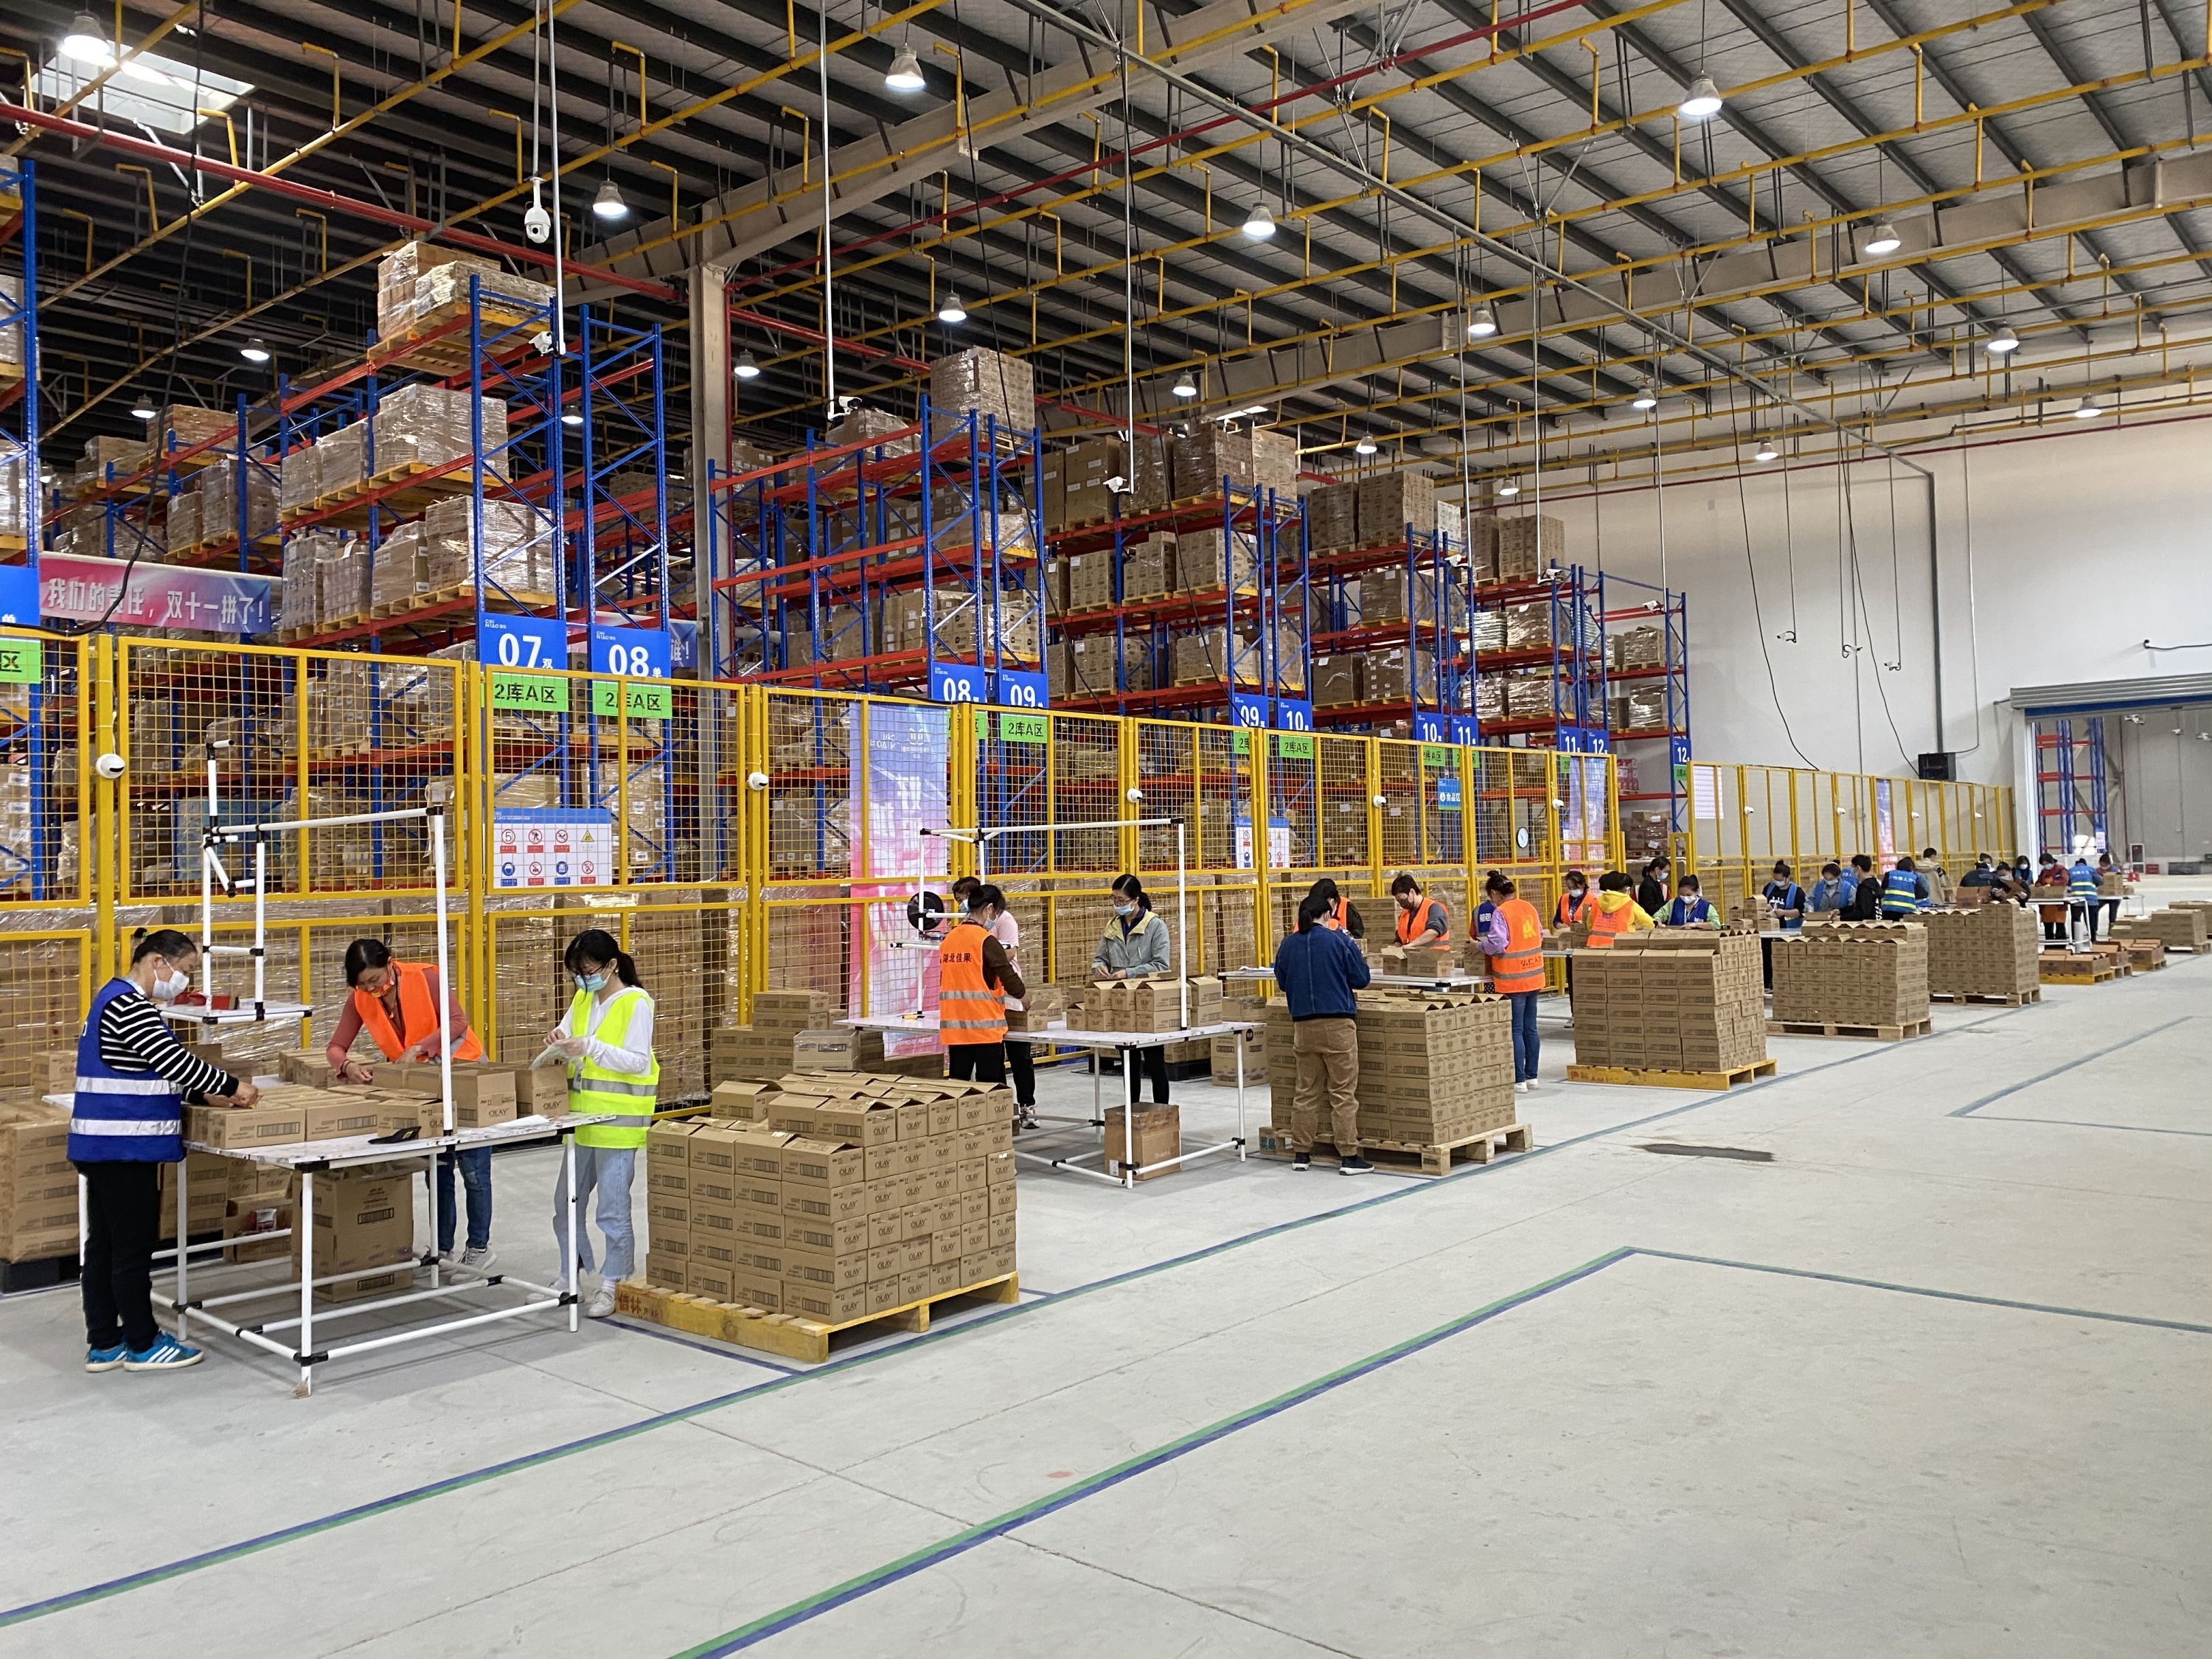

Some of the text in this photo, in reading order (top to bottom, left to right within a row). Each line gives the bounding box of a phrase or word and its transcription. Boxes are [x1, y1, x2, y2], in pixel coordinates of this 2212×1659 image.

[498, 633, 542, 668] 07
[608, 644, 650, 678] 08
[494, 683, 557, 704] 2库A区
[943, 678, 971, 702] 08
[1010, 684, 1036, 707] 09
[1240, 706, 1259, 727] 09
[1287, 711, 1304, 730] 10
[1008, 722, 1043, 737] 2库A区
[1422, 723, 1437, 742] 10
[1458, 726, 1471, 745] 11
[1565, 736, 1576, 752] 11
[1593, 738, 1604, 754] 12
[1677, 746, 1687, 762] 12
[505, 831, 512, 841] 5
[488, 1108, 509, 1117] OLAY
[543, 1101, 562, 1110] OLAY
